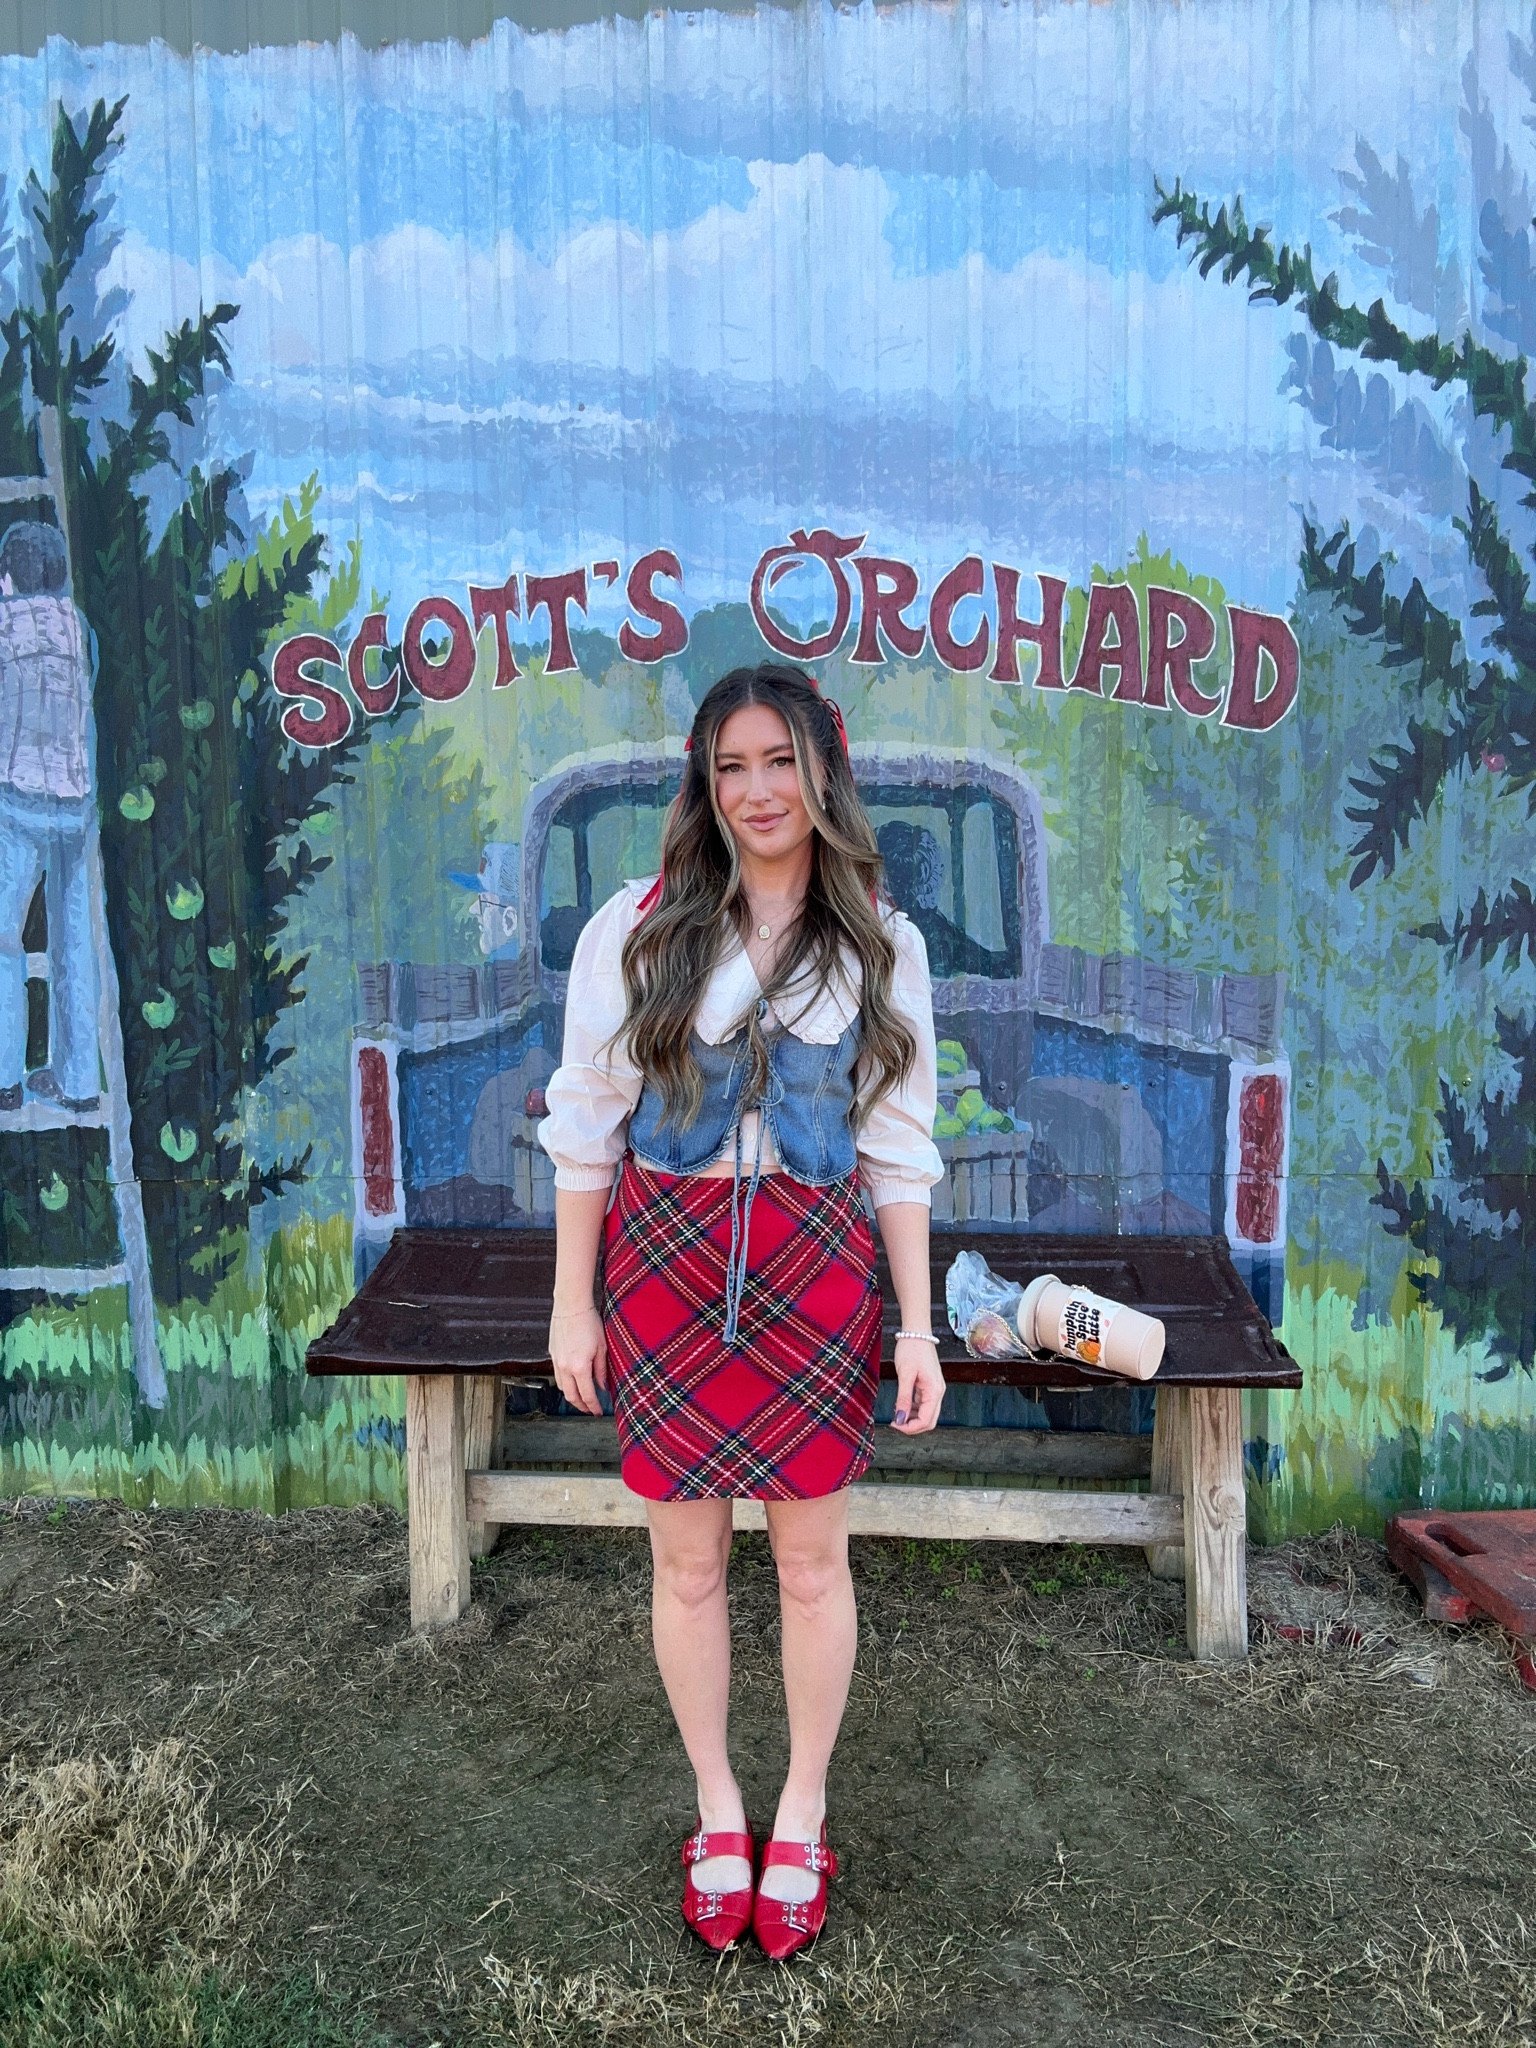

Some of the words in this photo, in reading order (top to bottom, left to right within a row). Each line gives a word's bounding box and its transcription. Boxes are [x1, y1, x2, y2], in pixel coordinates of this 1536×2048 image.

[272, 547, 690, 749] SCOTT'S
[749, 528, 1301, 733] ORCHARD
[1064, 1300, 1082, 1351] Pumpkin
[1075, 1305, 1090, 1340] Spice
[1087, 1308, 1101, 1344] Latte
